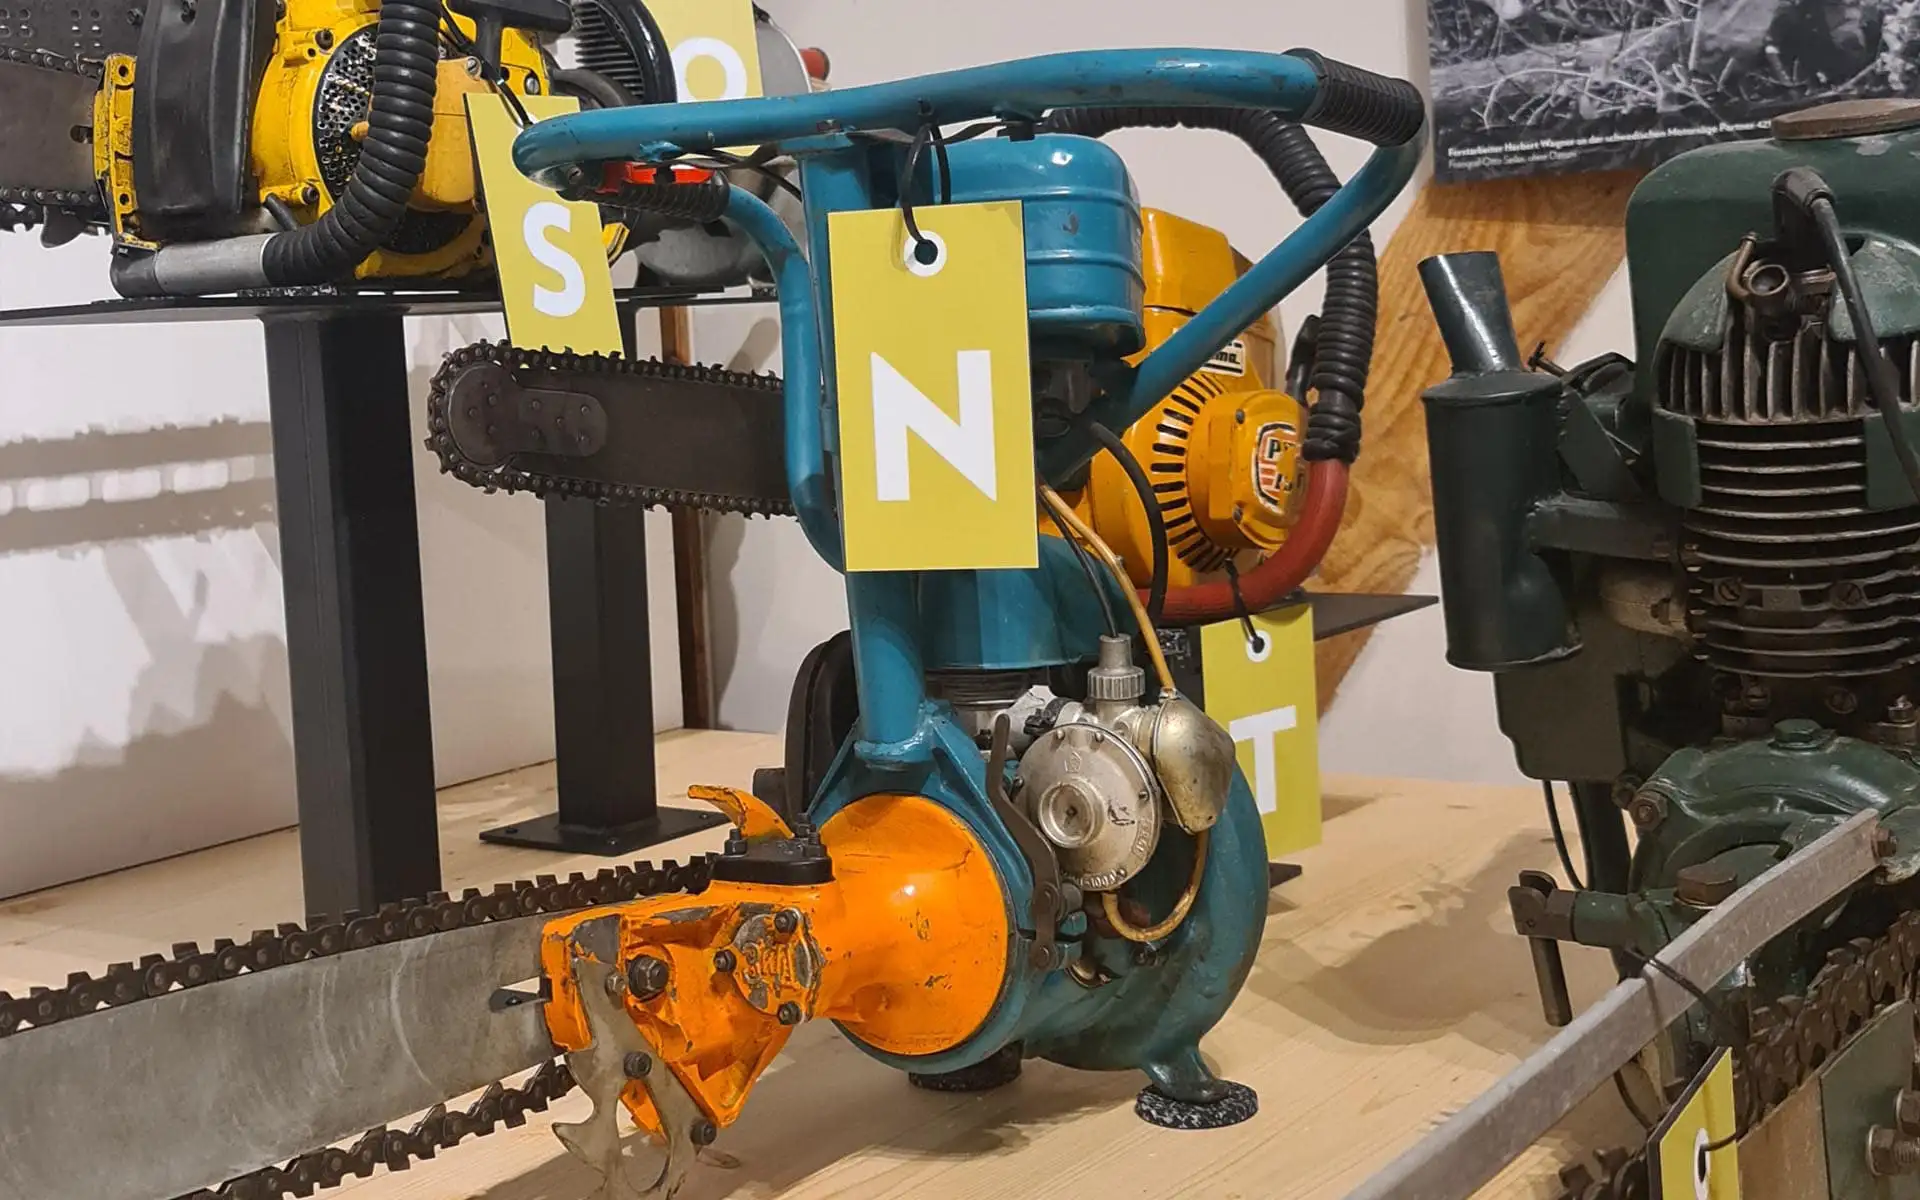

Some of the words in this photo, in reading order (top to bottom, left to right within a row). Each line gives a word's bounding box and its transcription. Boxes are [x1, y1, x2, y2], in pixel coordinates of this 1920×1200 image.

[672, 36, 747, 103] O
[1448, 144, 1499, 157] Forstarbeiter
[1504, 140, 1539, 152] Herbert
[1540, 138, 1574, 150] Wagner
[1604, 129, 1666, 143] schwedischen
[1667, 124, 1717, 138] Motorsäge
[523, 201, 586, 317] S
[870, 349, 996, 502] N
[1228, 705, 1297, 815] T
